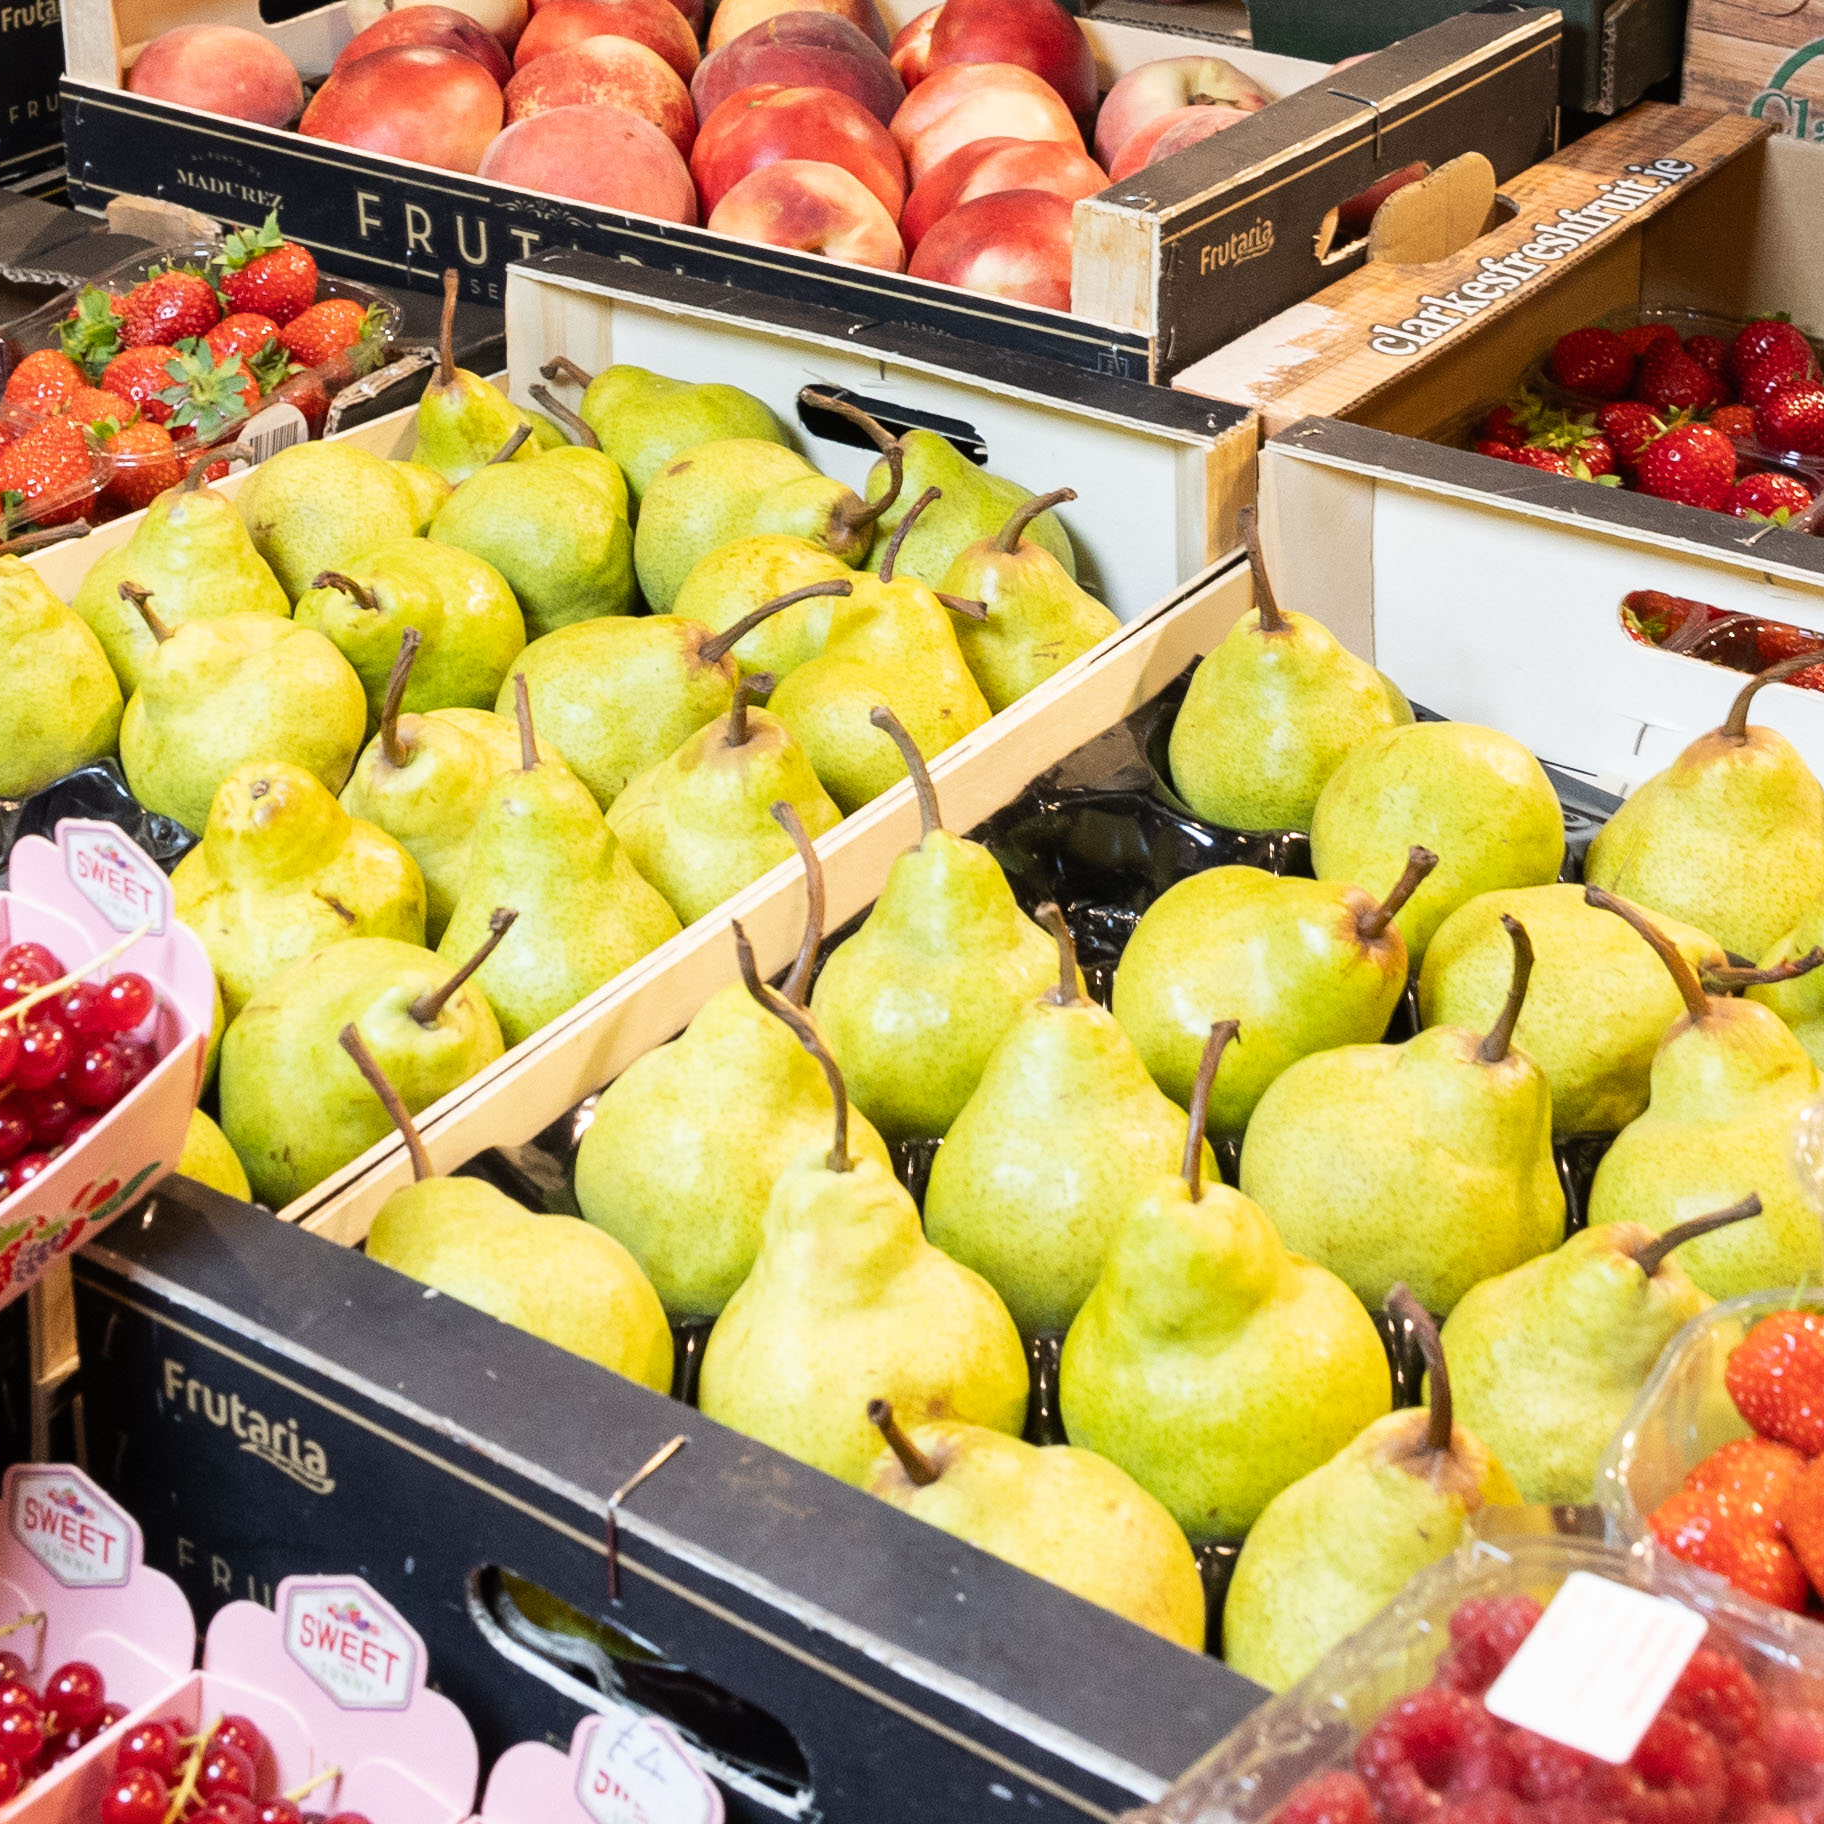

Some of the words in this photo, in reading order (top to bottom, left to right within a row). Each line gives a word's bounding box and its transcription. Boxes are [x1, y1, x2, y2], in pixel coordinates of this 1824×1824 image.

[176, 169, 285, 211] MADUREZ
[1199, 216, 1276, 277] Frutaria
[1369, 153, 1698, 358] clarkesfreshfruit.ie
[76, 848, 154, 914] SWEET
[163, 1357, 337, 1496] Frutaria
[23, 1496, 115, 1565] SWEET
[299, 1612, 401, 1687] SWEET
